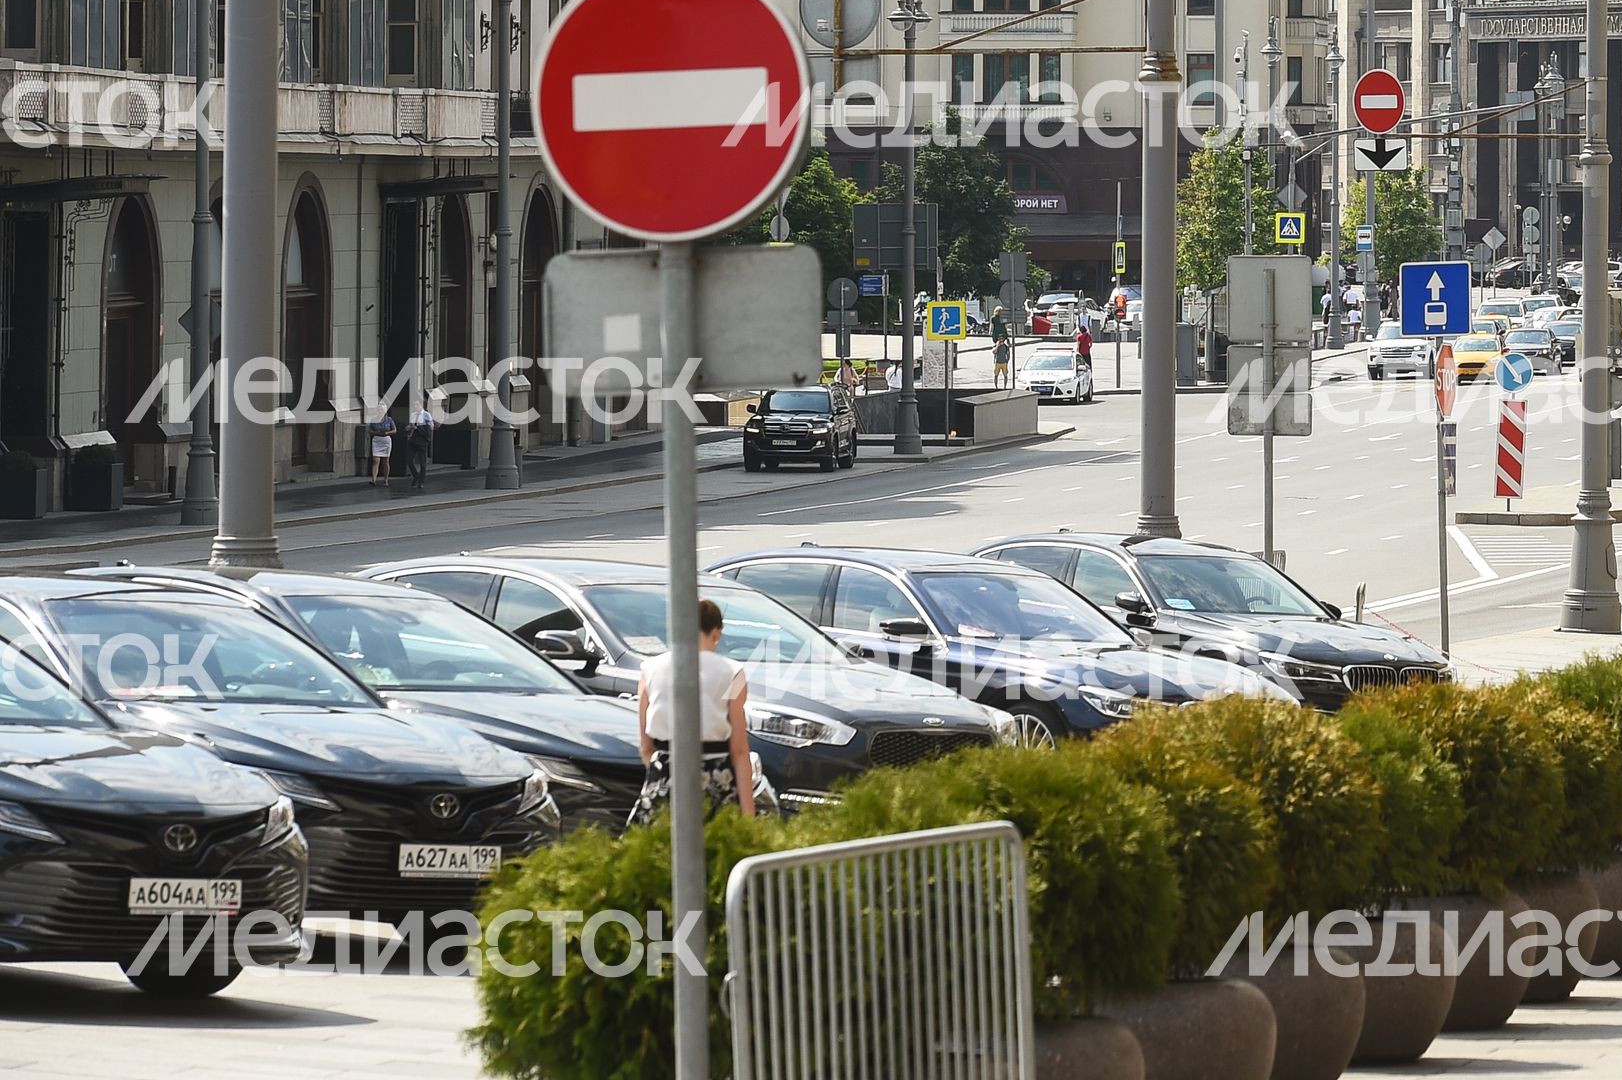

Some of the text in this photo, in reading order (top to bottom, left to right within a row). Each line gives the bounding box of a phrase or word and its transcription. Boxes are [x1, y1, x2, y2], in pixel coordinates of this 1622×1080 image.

[1480, 16, 1586, 37] ГОСУДАРСТВЕННАЯ
[1014, 197, 1059, 209] ОРОЙ НЕТ
[1436, 368, 1456, 392] STOP
[210, 881, 238, 900] 199
